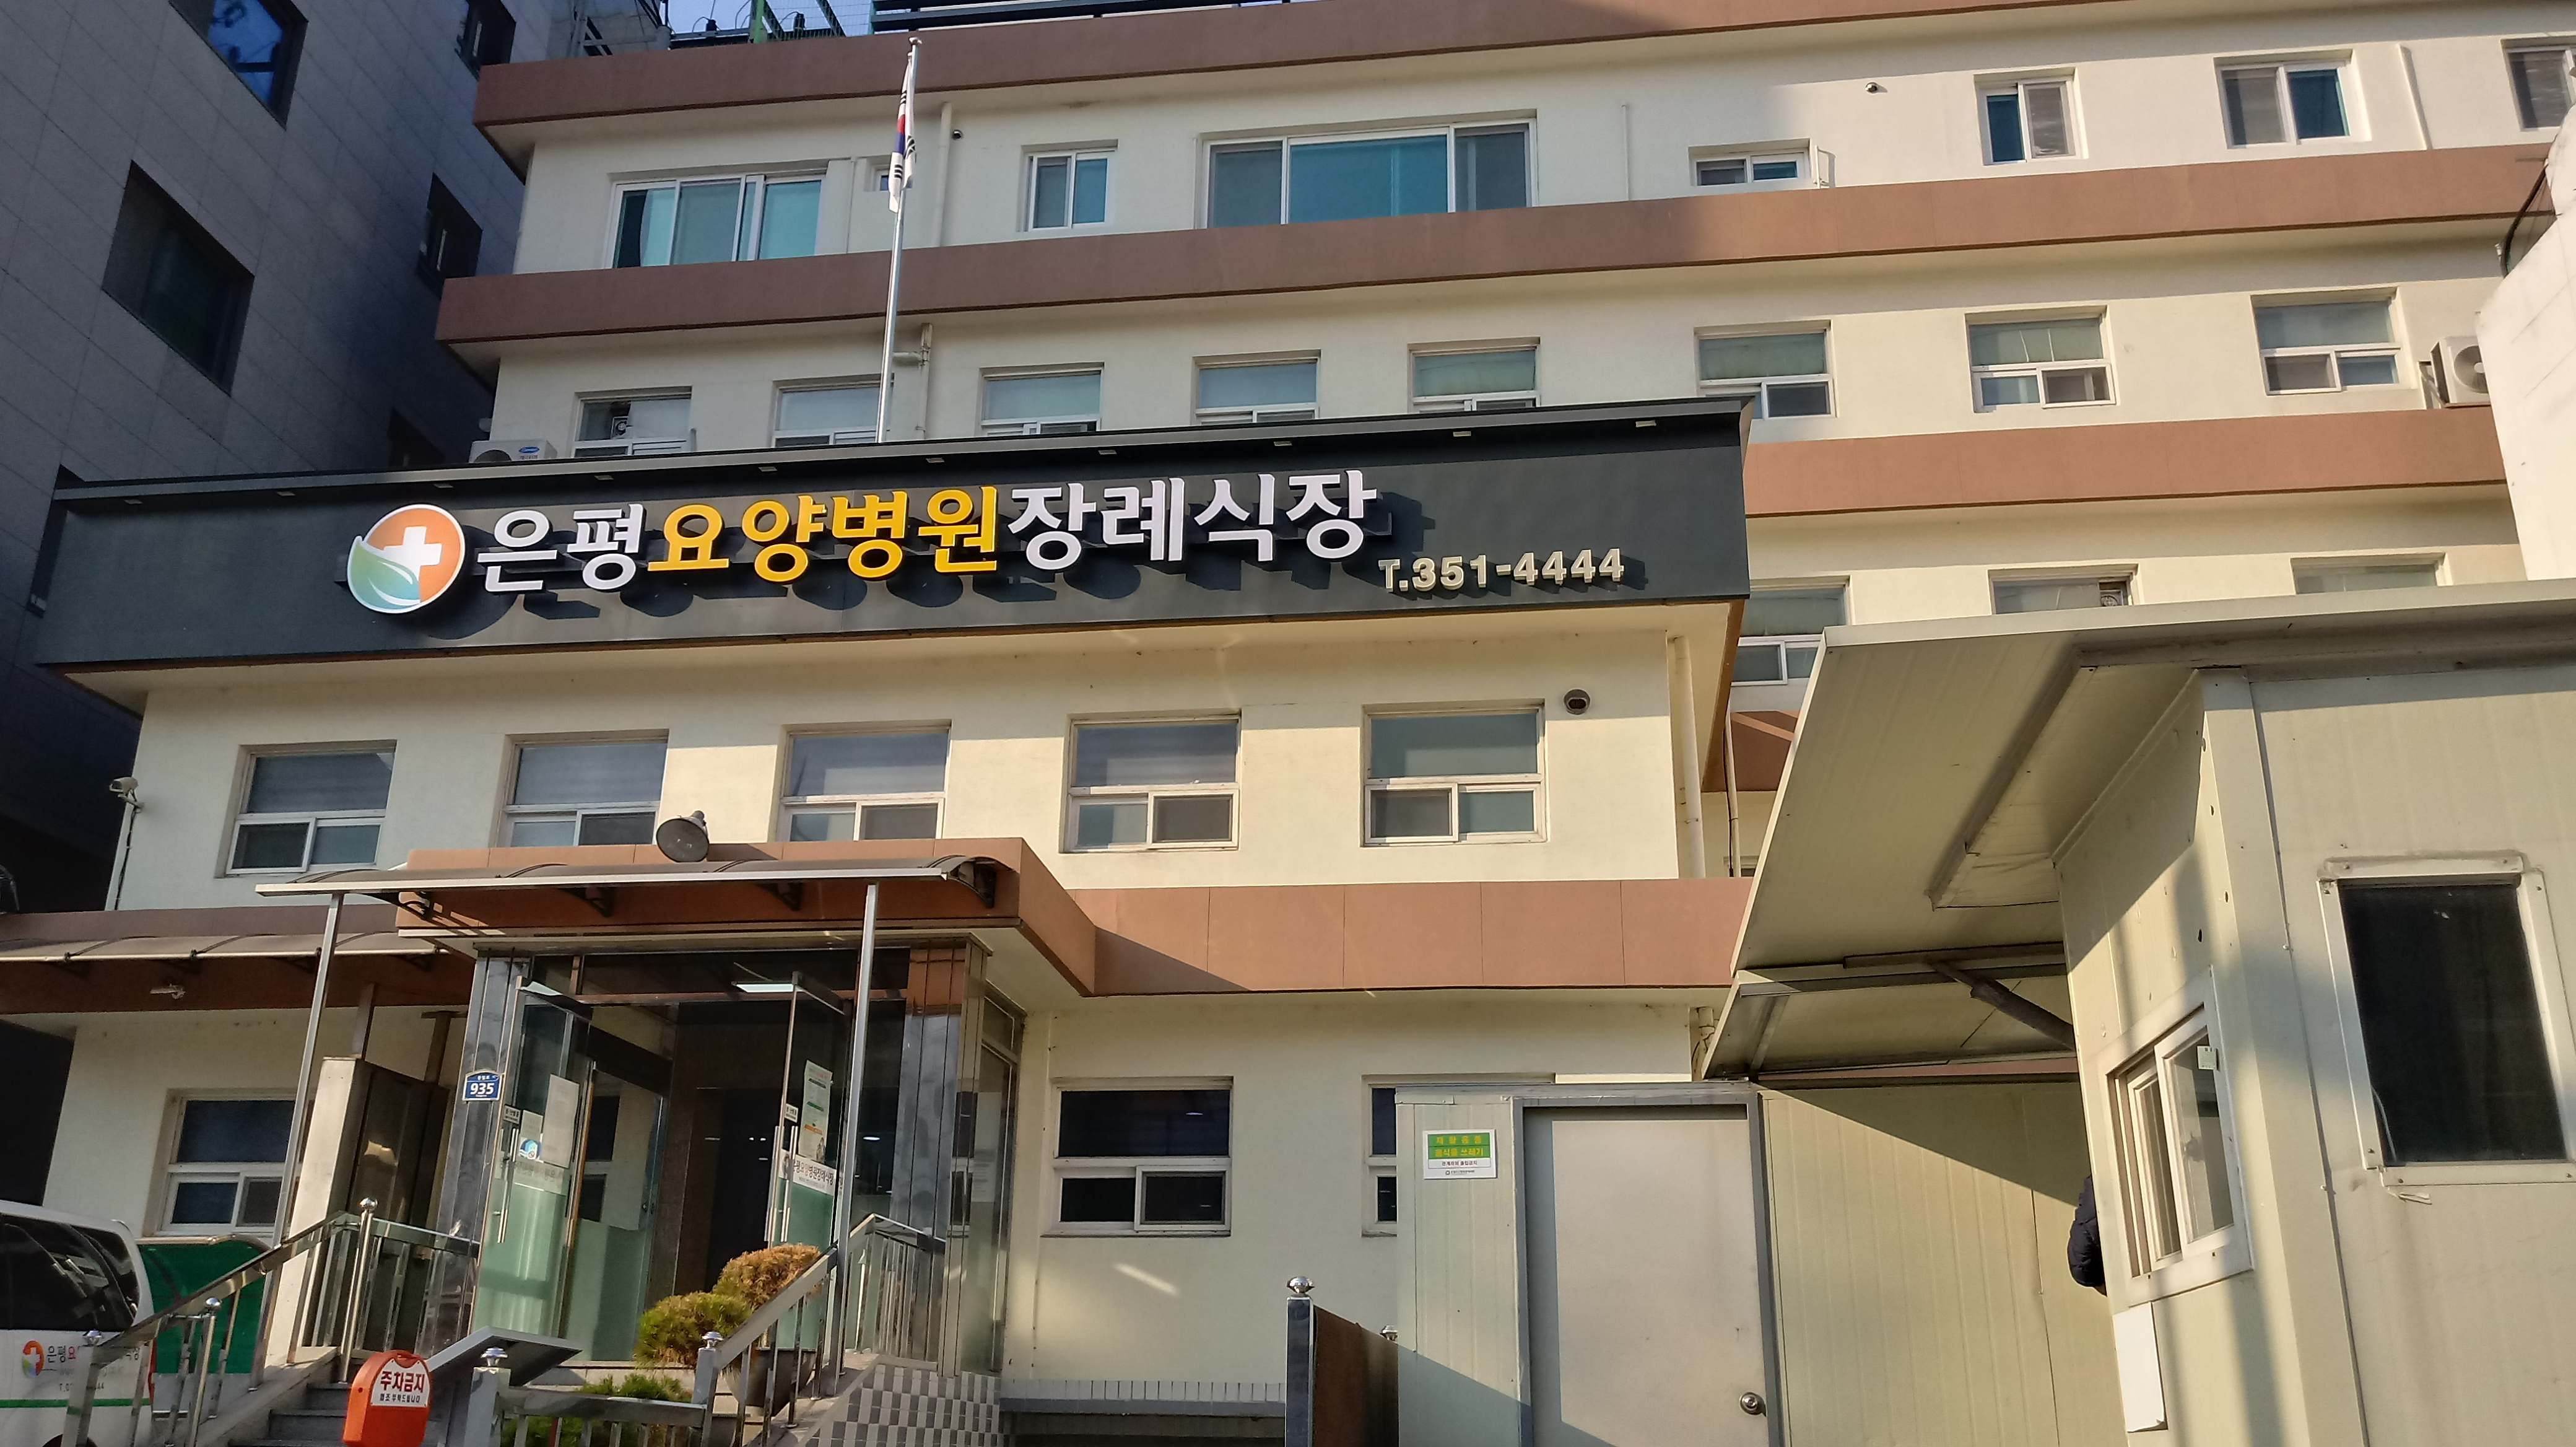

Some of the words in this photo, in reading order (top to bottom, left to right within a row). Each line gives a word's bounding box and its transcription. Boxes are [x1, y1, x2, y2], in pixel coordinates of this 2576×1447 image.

[1382, 548, 1625, 594] T.351-4444
[470, 1083, 495, 1095] 935
[1461, 1148, 1483, 1156] 쓰레기
[794, 1161, 833, 1186] 평요양병원장례식장
[380, 1371, 425, 1393] 주차금지
